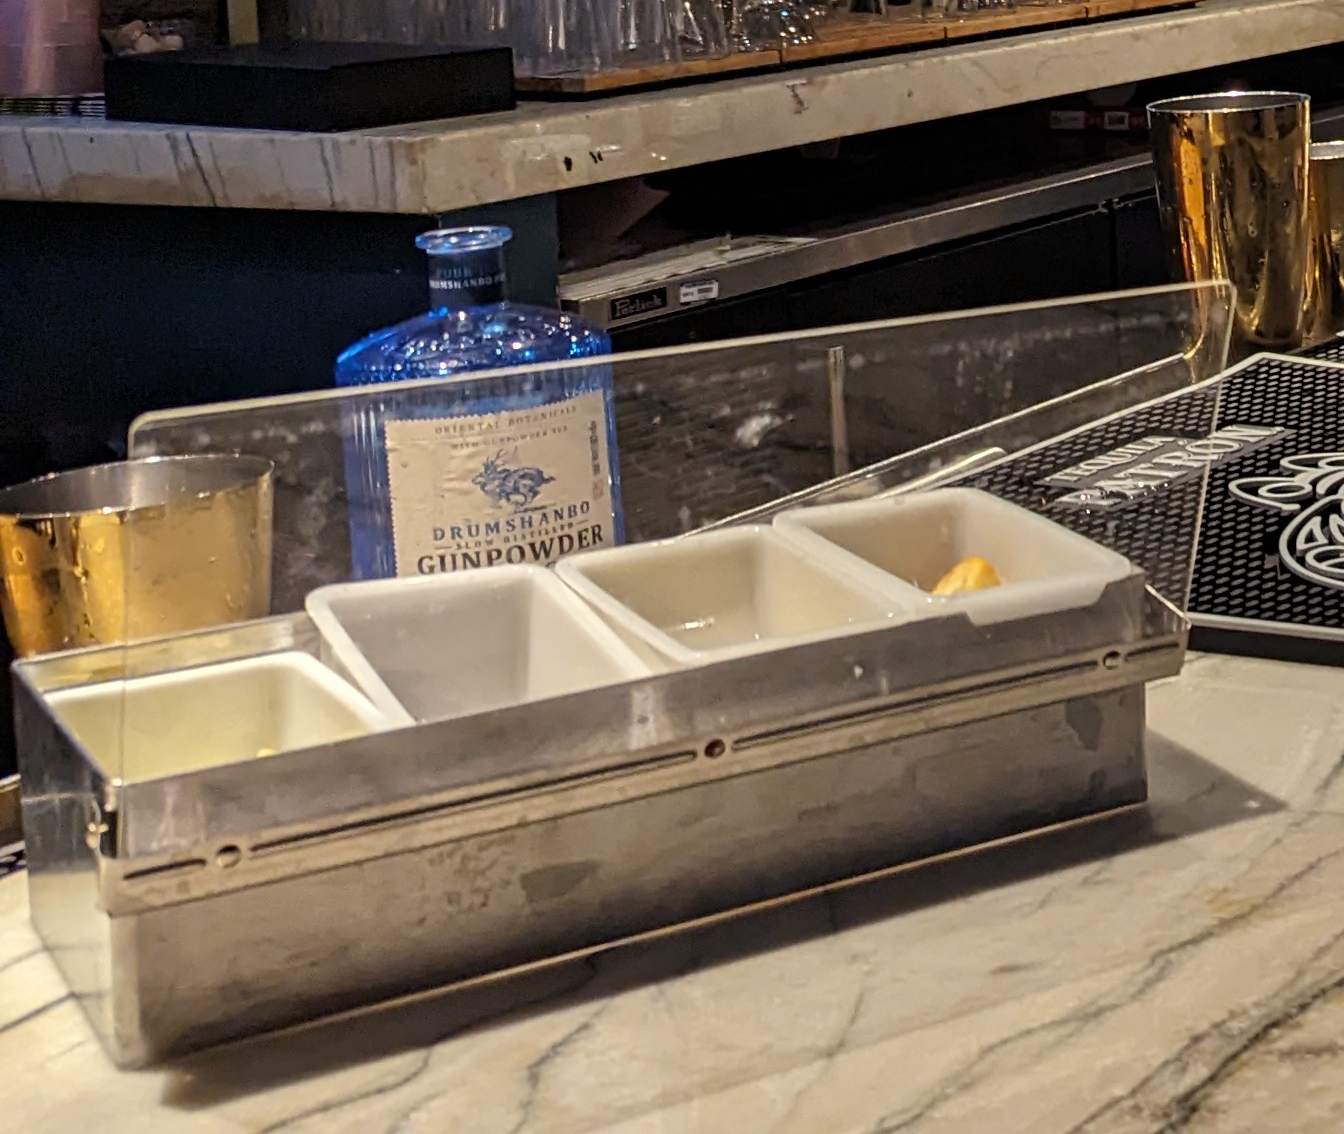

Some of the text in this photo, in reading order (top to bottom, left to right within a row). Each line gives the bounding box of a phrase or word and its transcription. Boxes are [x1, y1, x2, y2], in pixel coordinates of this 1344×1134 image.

[434, 421, 500, 435] ORIENTAL
[1043, 435, 1177, 482] TEQUILA
[432, 500, 591, 542] DRUMSHANBO
[417, 523, 604, 576] GUNPOWDER
[456, 538, 495, 551] SLOW
